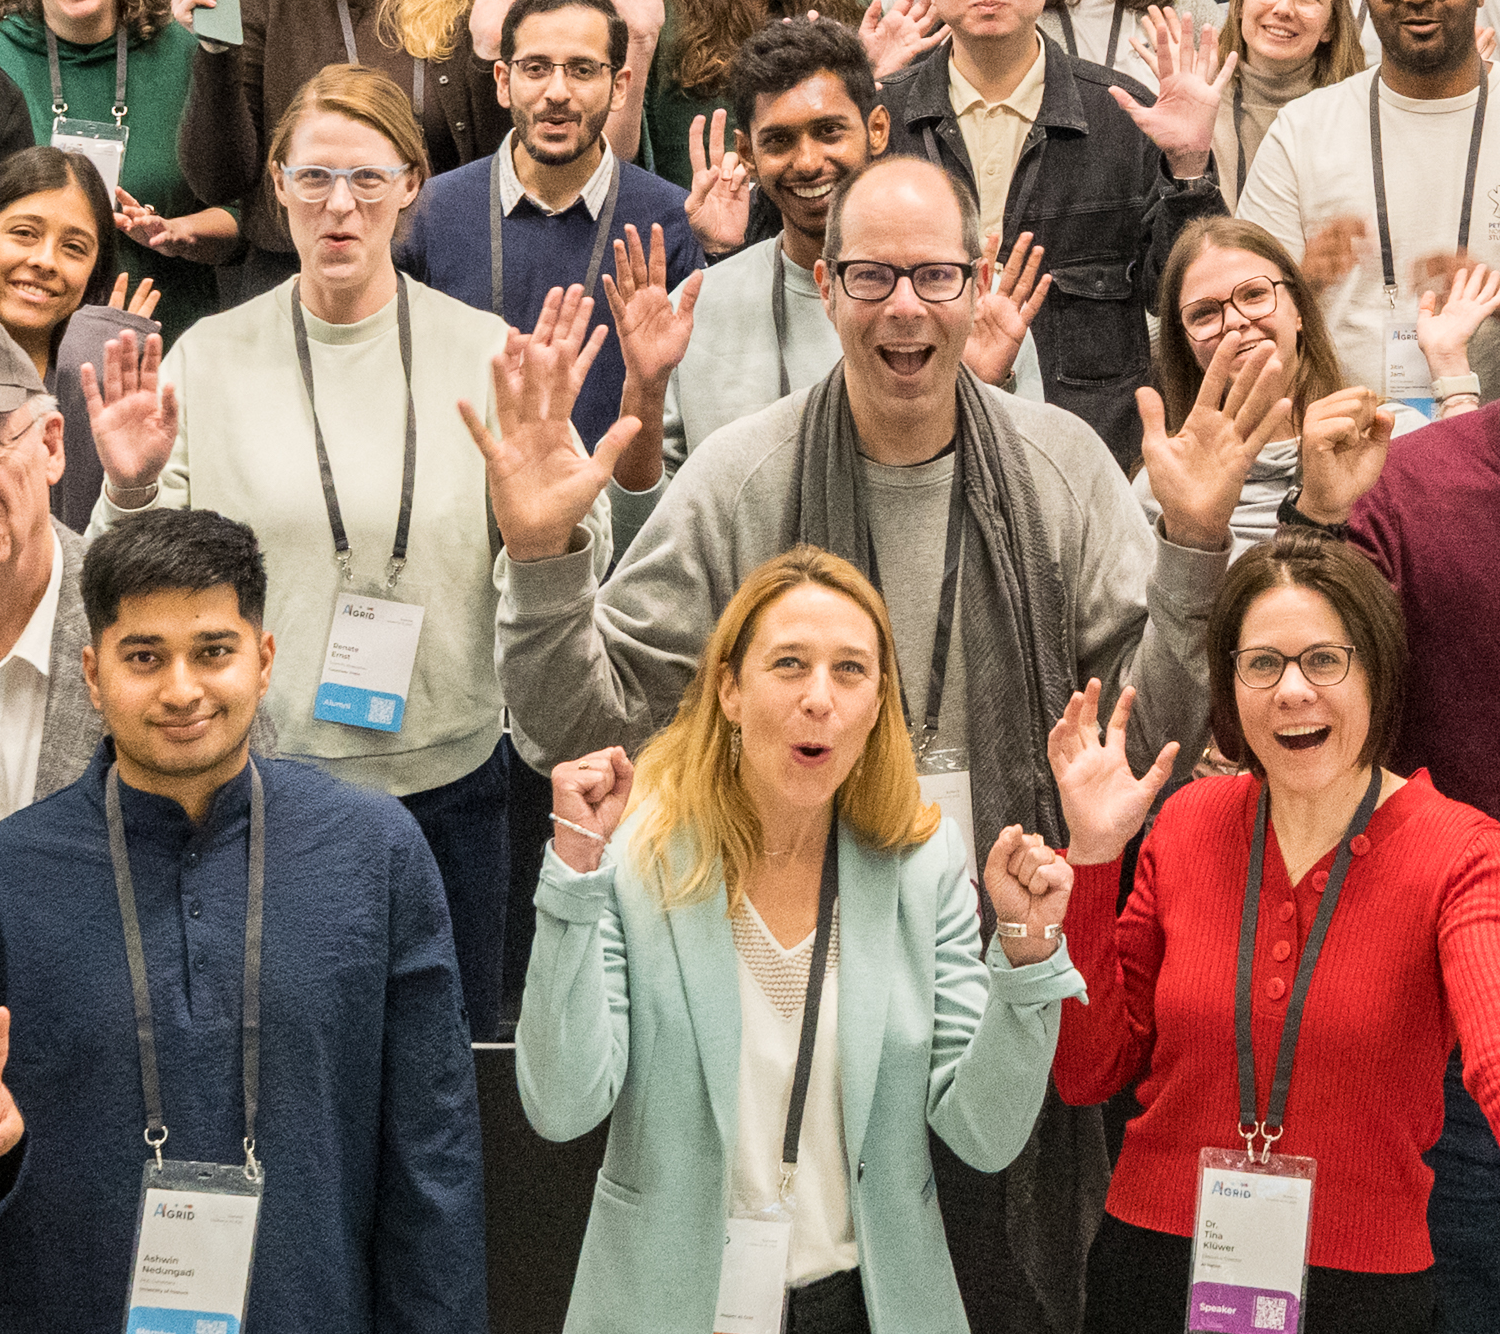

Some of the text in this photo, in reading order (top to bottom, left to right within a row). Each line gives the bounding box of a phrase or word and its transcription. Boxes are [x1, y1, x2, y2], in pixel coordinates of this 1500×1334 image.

[331, 651, 351, 660] Ernst
[1205, 1220, 1218, 1230] Dr.
[1204, 1230, 1223, 1240] Tina
[1203, 1240, 1235, 1253] Klüwer
[143, 1254, 179, 1265] Ashwin
[142, 1265, 195, 1278] Nedungadi
[1199, 1302, 1237, 1315] Speaker
